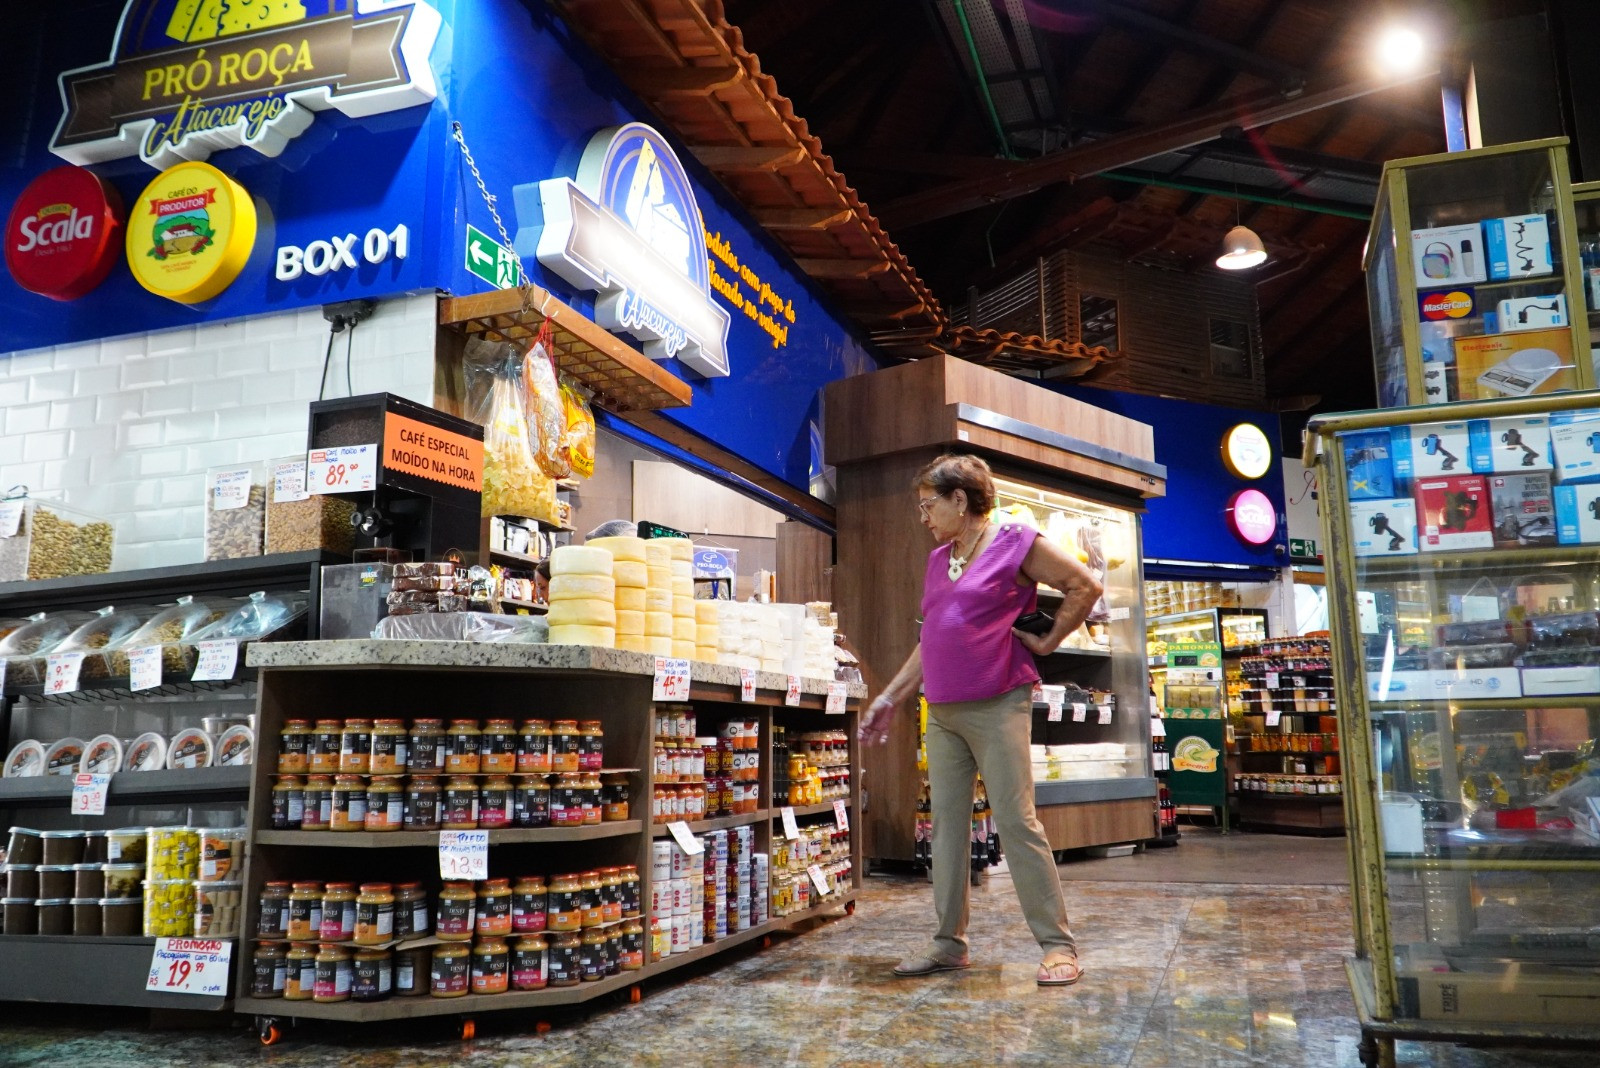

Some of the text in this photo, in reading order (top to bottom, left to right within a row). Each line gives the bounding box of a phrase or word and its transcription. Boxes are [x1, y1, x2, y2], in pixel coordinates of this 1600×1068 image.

[142, 39, 314, 100] PRÓ ROÇA
[147, 92, 283, 156] Atacarejo
[160, 197, 205, 213] PRODUTOR
[168, 187, 198, 199] CAFÉ DO
[18, 208, 94, 252] Scala
[276, 223, 408, 281] BOX 01
[708, 259, 744, 309] tacado
[744, 299, 759, 321] no
[740, 264, 761, 292] com
[621, 291, 686, 355] Atacarejo
[1424, 300, 1472, 313] MasterCard
[400, 428, 470, 461] CAFÉ ESPECIAL
[391, 448, 476, 483] MOÍDO NA HORA
